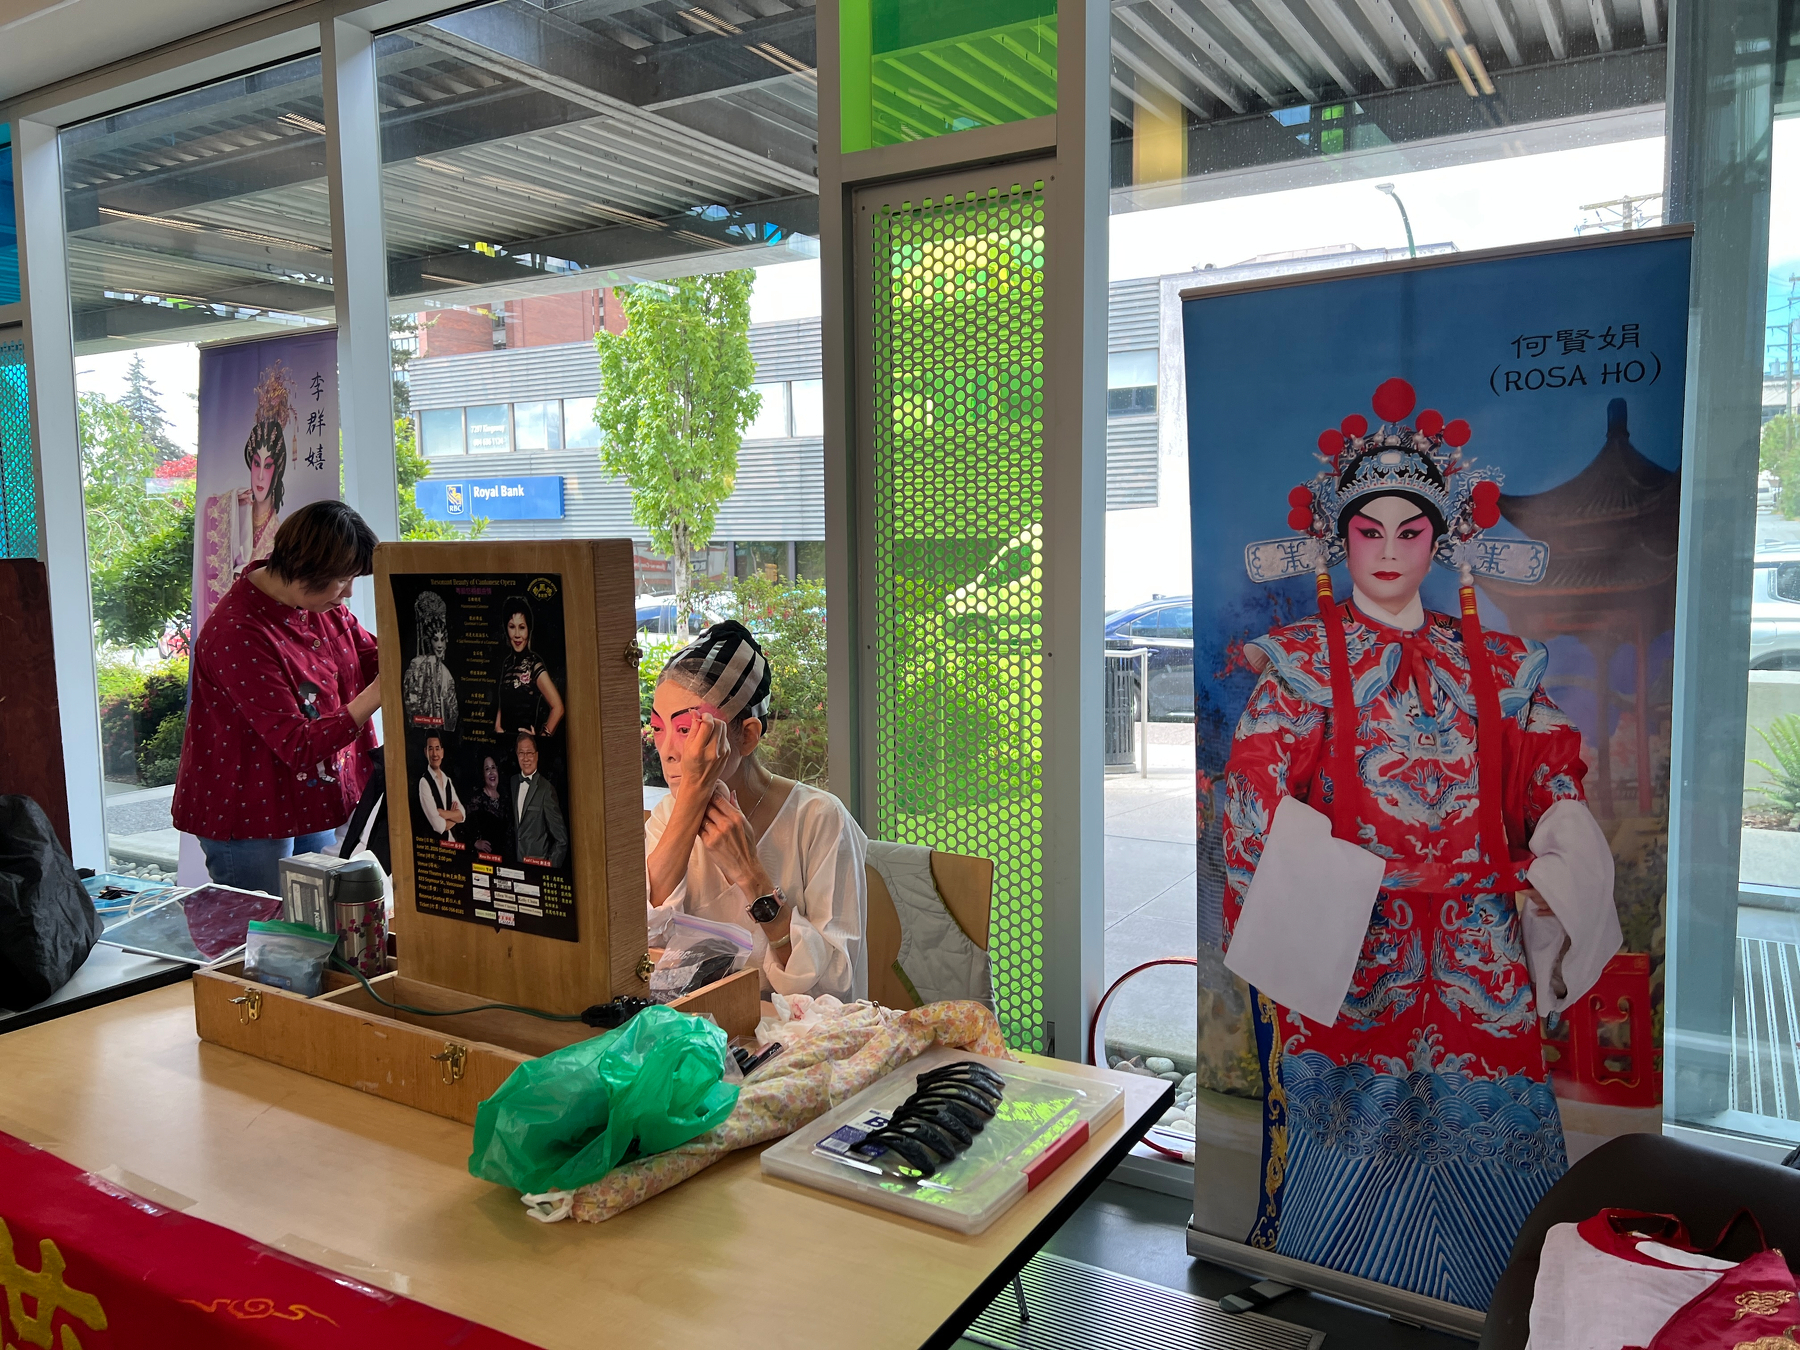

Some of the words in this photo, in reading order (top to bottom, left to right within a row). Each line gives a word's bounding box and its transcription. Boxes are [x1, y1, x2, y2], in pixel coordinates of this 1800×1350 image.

[1510, 323, 1640, 359] 何賢娟
[1490, 364, 1588, 397] (ROSA
[1601, 351, 1662, 386] HO)
[473, 485, 498, 500] Royal
[500, 484, 524, 497] Bank
